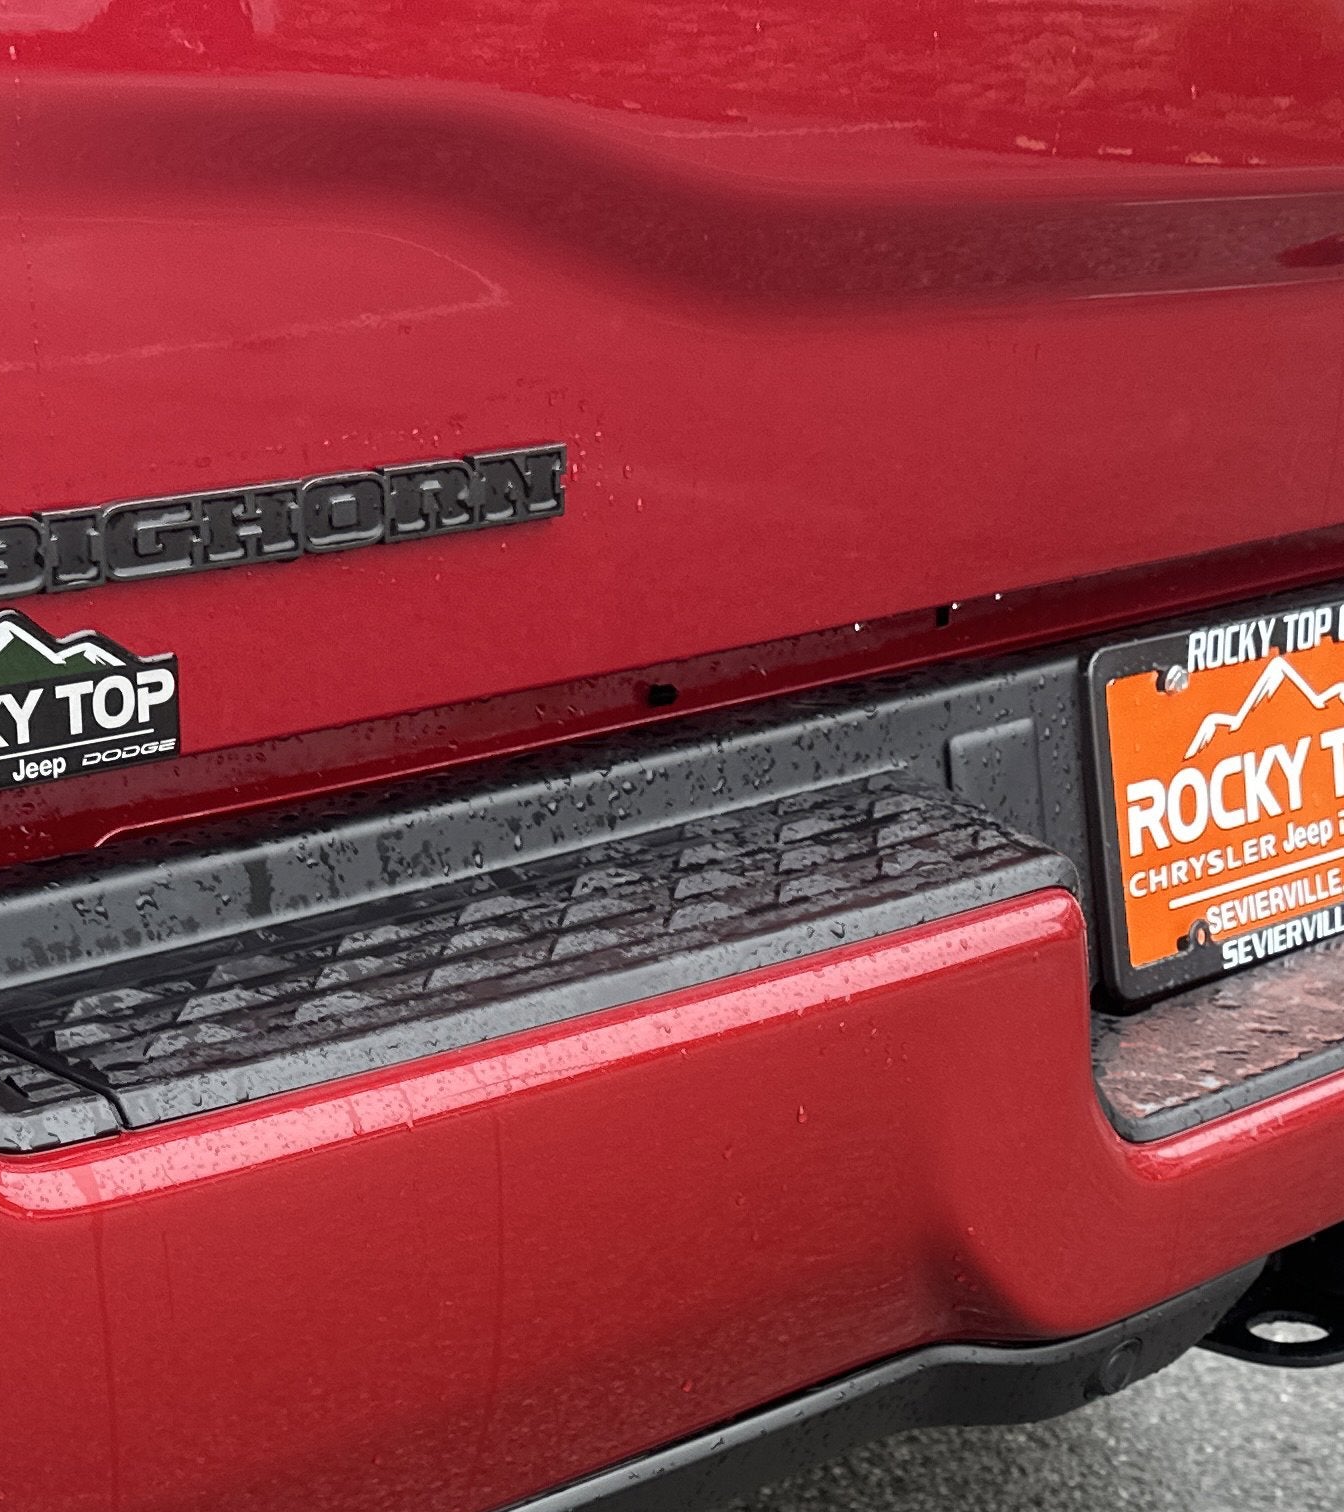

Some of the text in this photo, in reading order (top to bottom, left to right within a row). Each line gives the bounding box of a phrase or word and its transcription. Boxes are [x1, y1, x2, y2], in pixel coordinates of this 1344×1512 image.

[1187, 617, 1275, 672] ROCKY
[1283, 607, 1332, 652] TOP
[65, 668, 176, 736] TOP
[12, 751, 67, 783] Jeep
[81, 737, 177, 767] DODGE
[1126, 735, 1312, 857] ROCKY
[1129, 834, 1277, 898] CHRYSLER
[1282, 819, 1333, 853] Jeep
